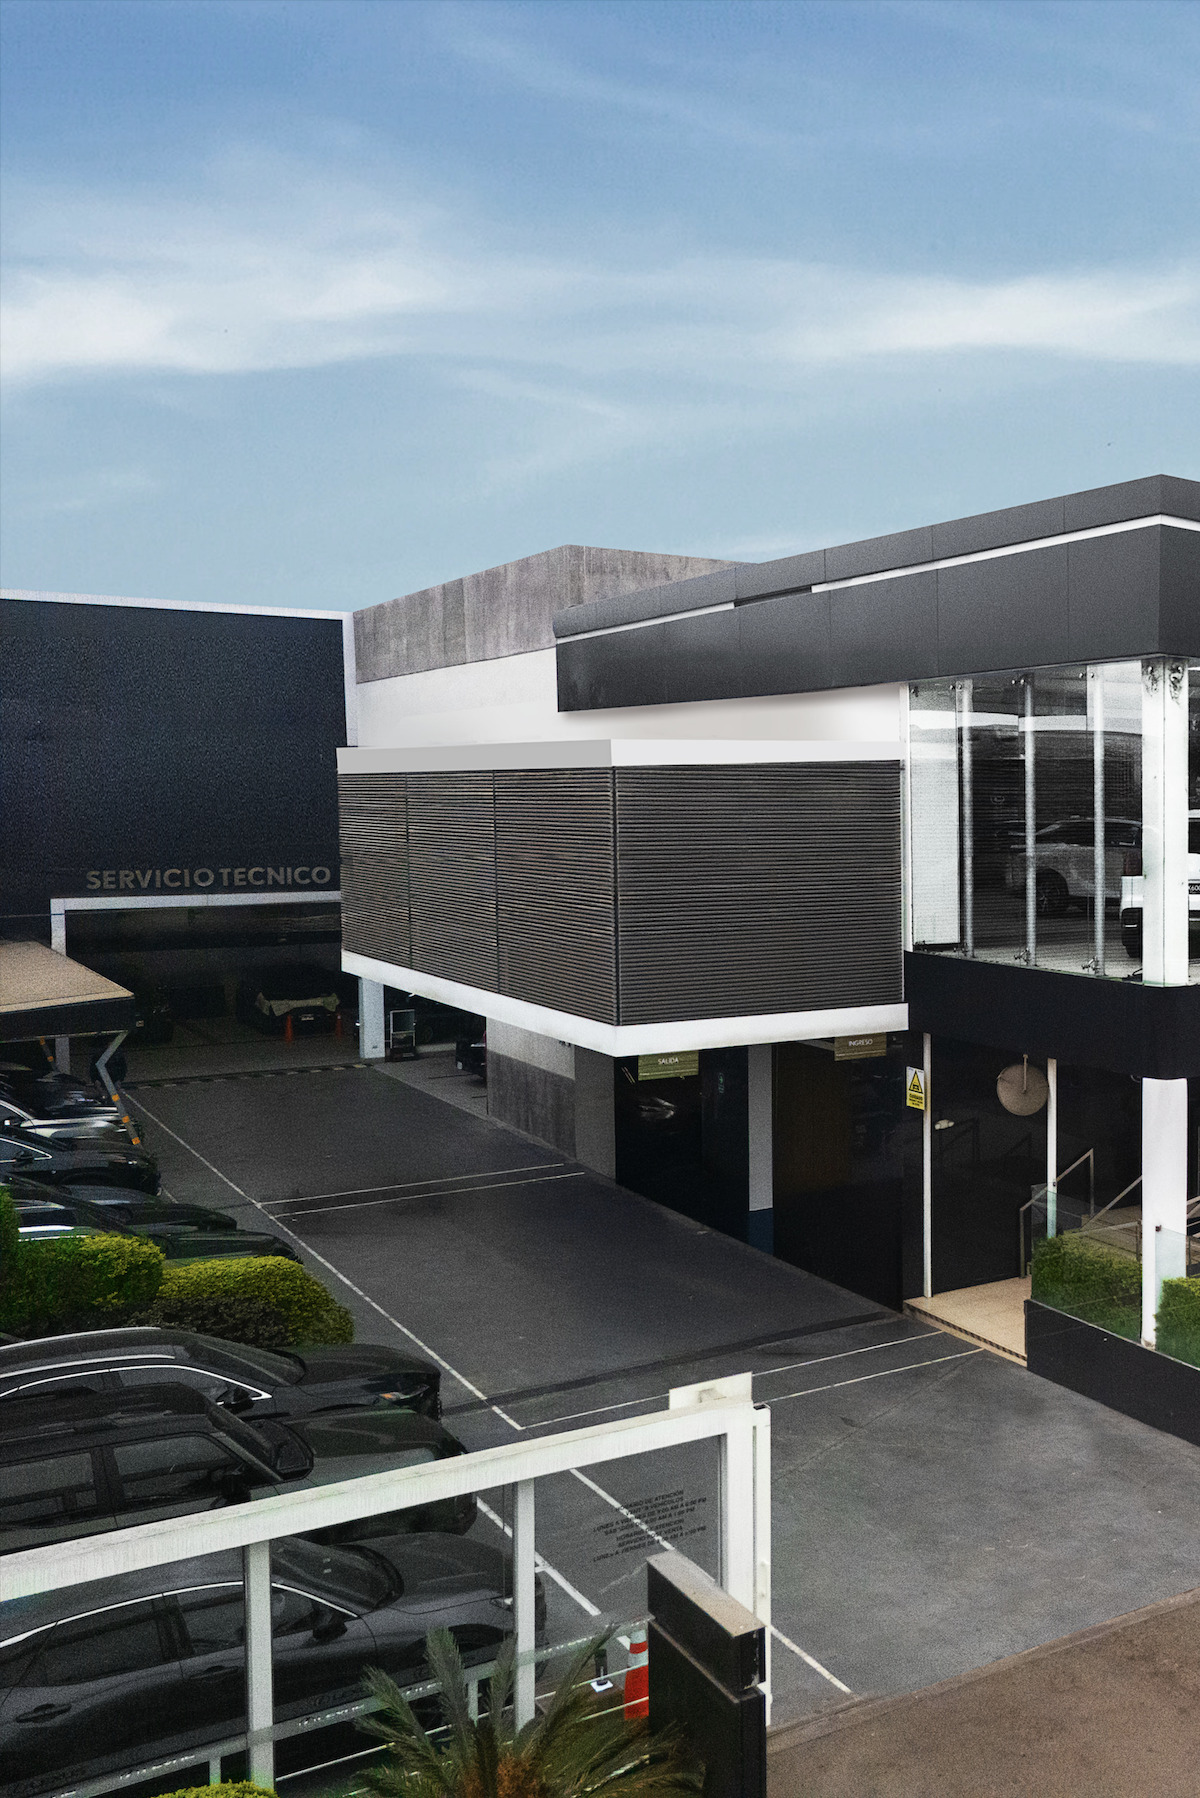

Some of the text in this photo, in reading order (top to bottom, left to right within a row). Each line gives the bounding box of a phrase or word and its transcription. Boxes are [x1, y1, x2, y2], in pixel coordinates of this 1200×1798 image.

[86, 866, 331, 889] SERVICIO TECNICO
[848, 1038, 873, 1046] INGRESO
[657, 1057, 679, 1065] SALIDA
